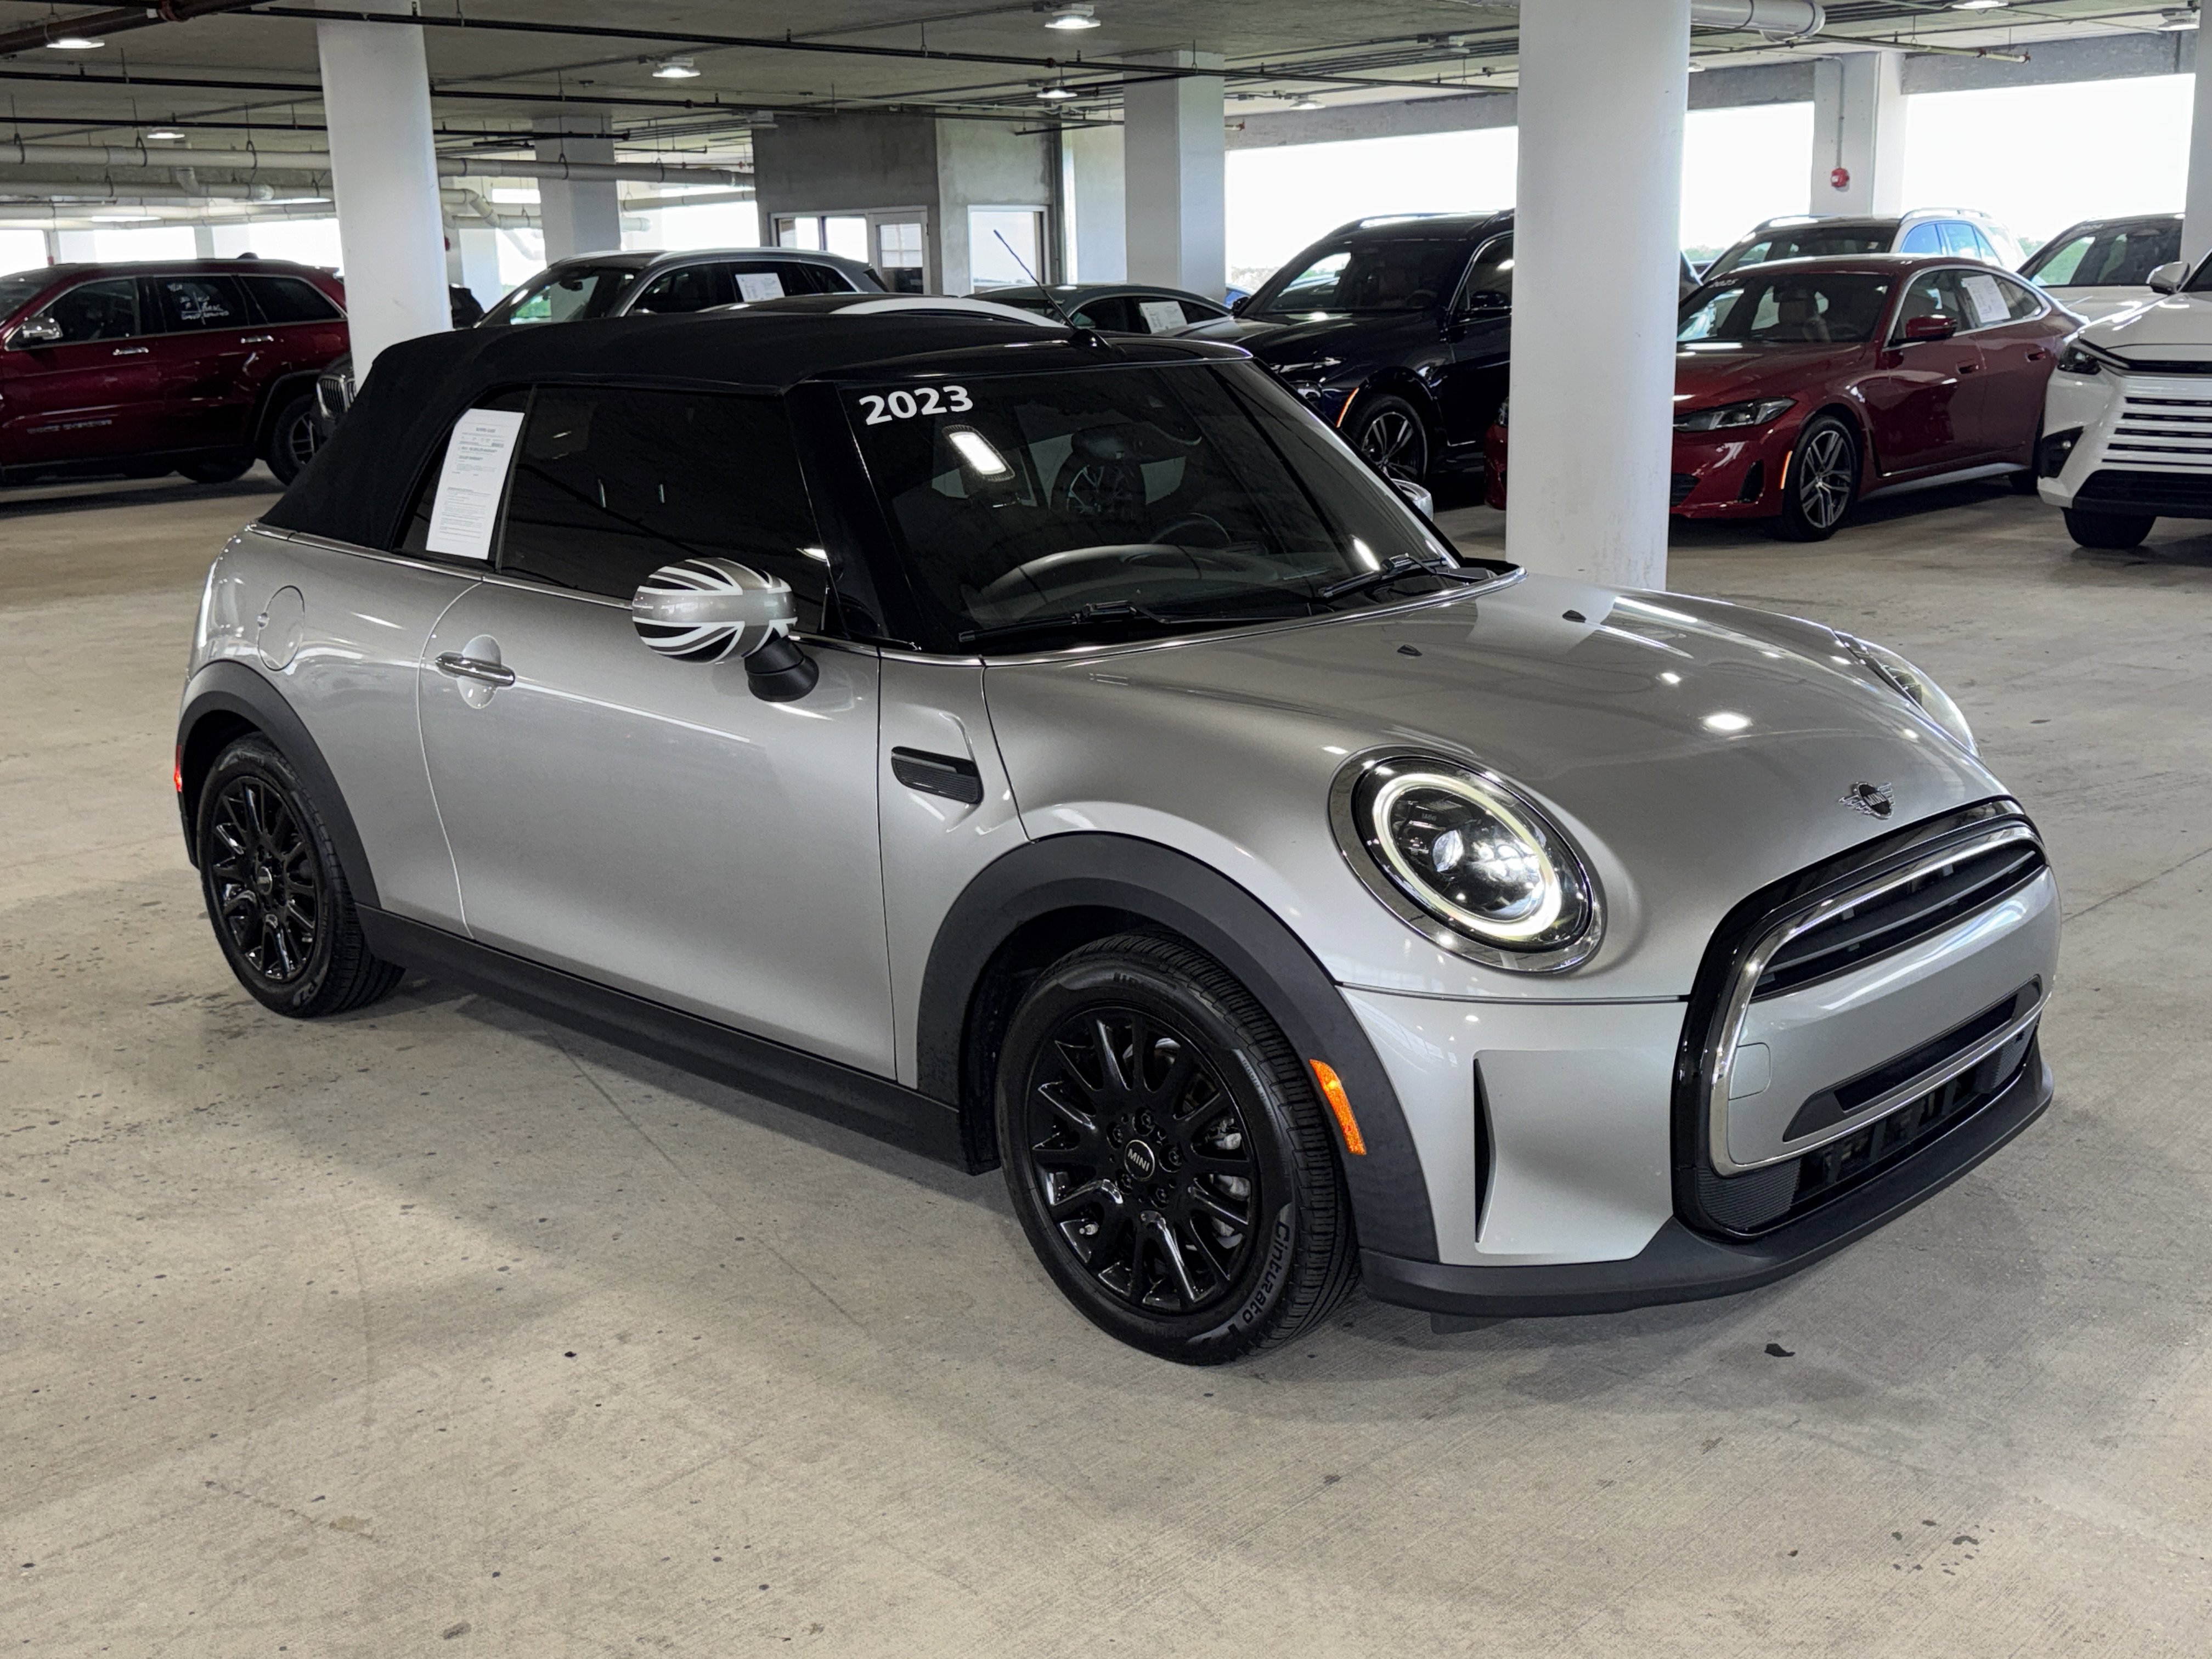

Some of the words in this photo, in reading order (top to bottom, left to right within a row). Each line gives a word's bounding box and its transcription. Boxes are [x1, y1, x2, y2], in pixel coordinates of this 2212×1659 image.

[859, 385, 973, 426] 2023
[1864, 791, 1887, 806] MINI
[1127, 1148, 1150, 1172] MINI
[1242, 1220, 1291, 1324] Cinturato
